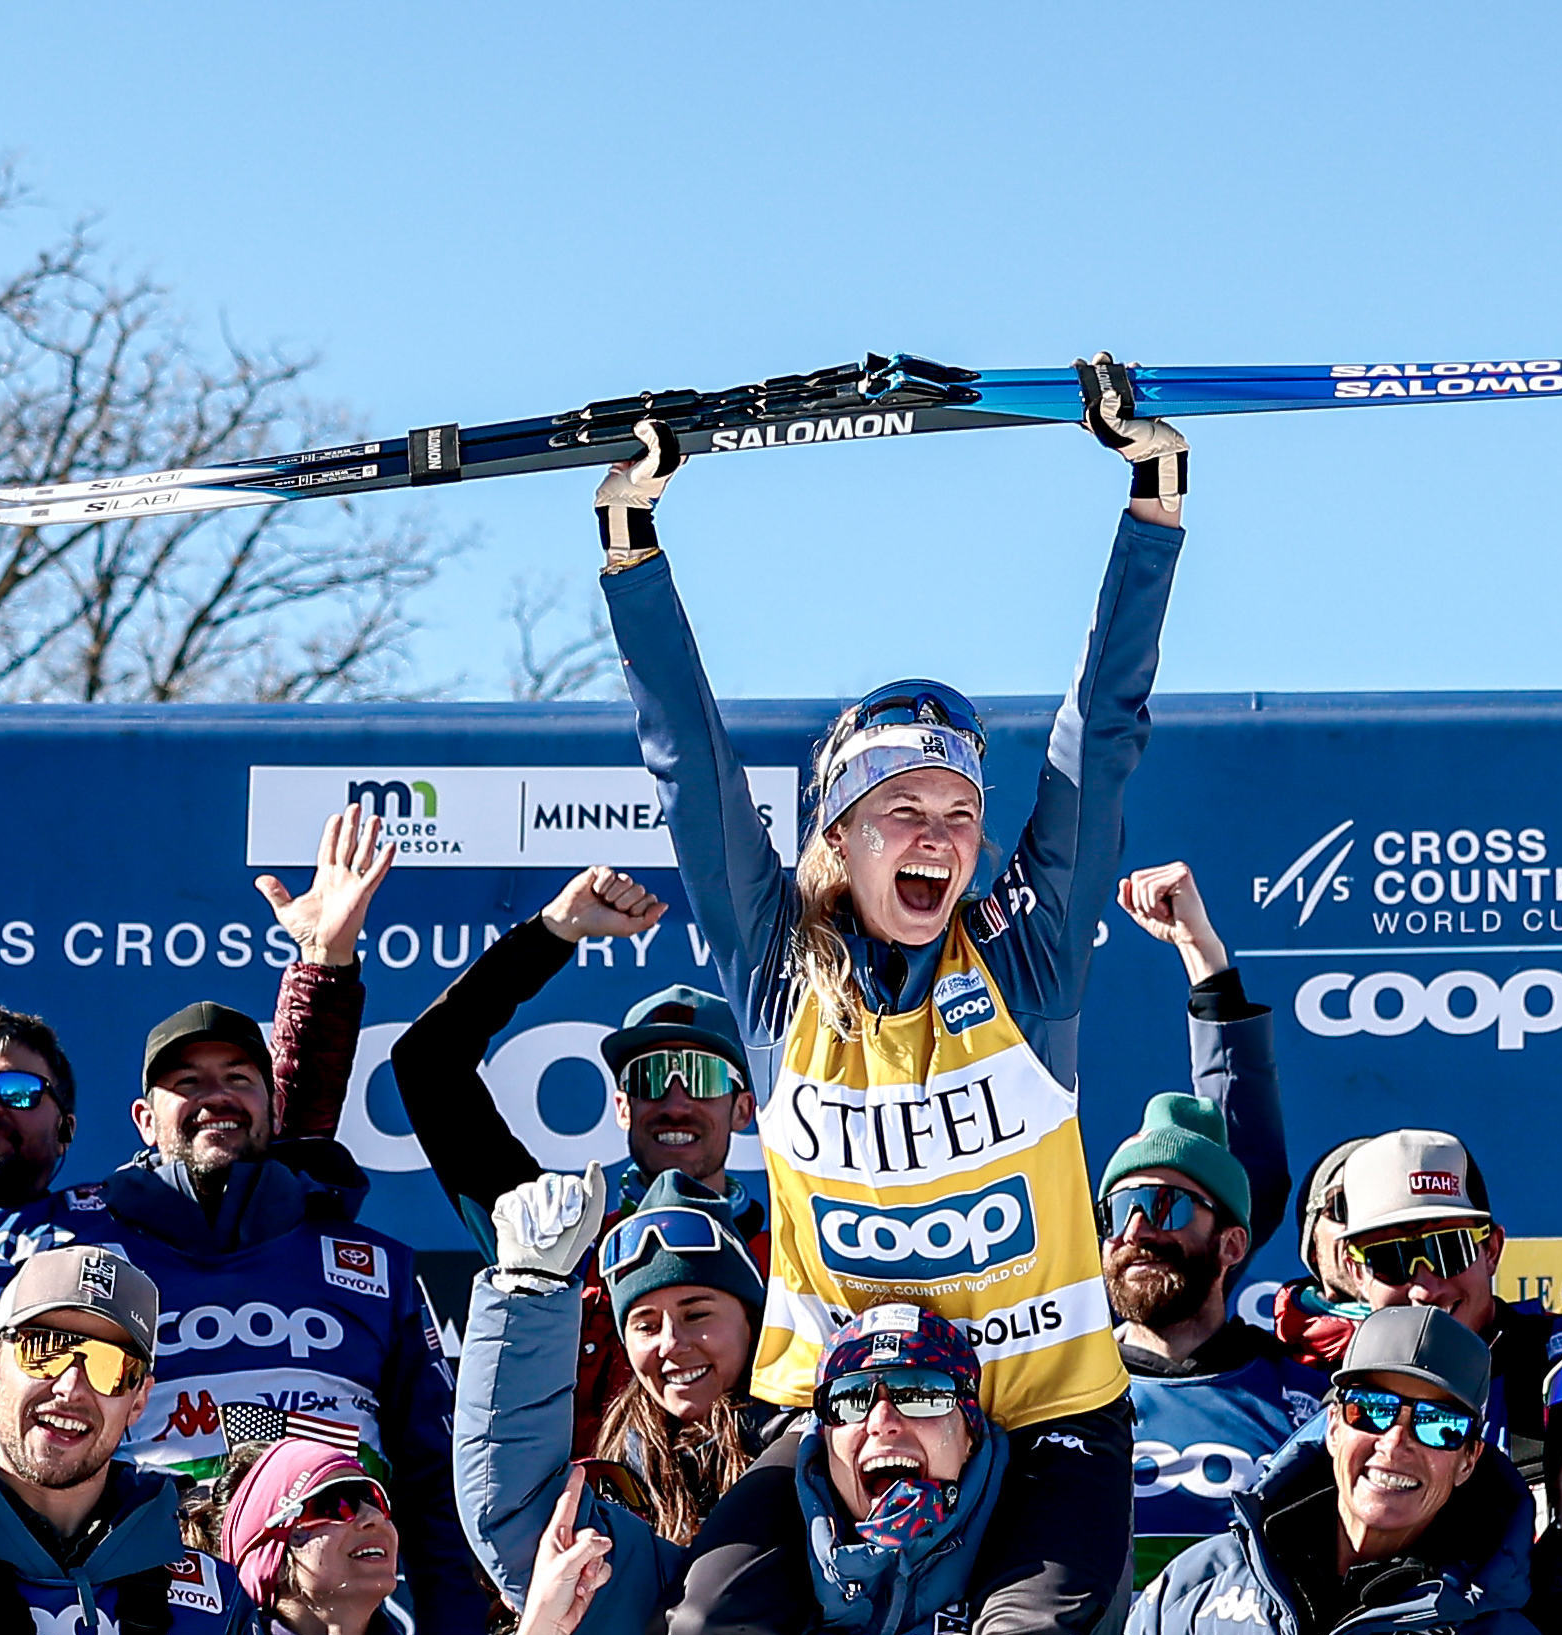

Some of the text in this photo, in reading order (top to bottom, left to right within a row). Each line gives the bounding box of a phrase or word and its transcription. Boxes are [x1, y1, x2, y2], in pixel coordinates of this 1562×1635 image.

[711, 411, 914, 453] SALOMON
[921, 735, 944, 748] US
[534, 804, 773, 832] MINNEAS
[1372, 830, 1547, 865] CROSS
[1253, 878, 1351, 904] FIS
[1372, 911, 1502, 934] WORLD
[63, 921, 299, 968] CROSS
[945, 998, 991, 1024] coop
[791, 1074, 1026, 1174] STIFEL
[1410, 1176, 1451, 1191] UTAH
[820, 1193, 1022, 1263] coop
[82, 1256, 116, 1277] US
[846, 1259, 1038, 1298] CROSS COUNTRY WORLD CUP
[326, 1272, 388, 1298] TOYOTA
[875, 1333, 899, 1344] US
